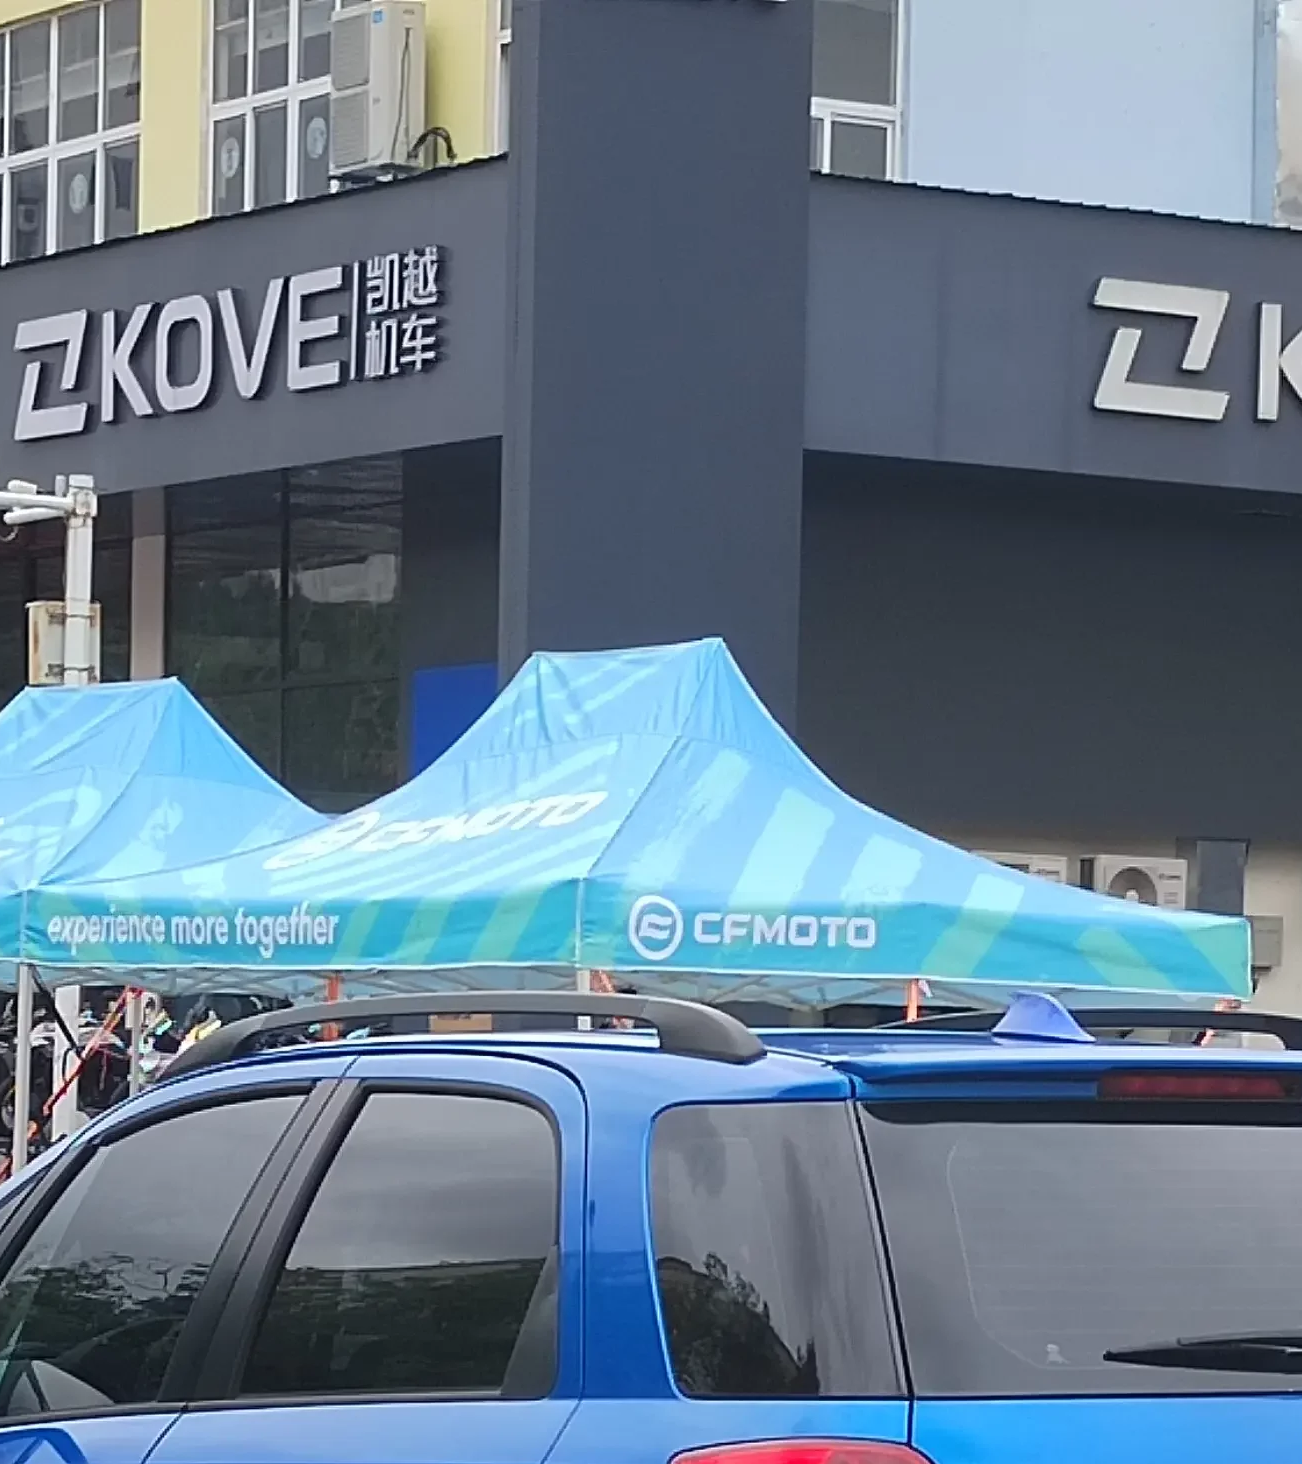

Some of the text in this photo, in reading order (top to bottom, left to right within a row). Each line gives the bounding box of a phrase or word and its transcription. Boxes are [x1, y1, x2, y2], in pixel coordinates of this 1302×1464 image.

[366, 245, 438, 314] 凯越
[101, 265, 343, 423] KOVE
[365, 312, 437, 376] 机车
[47, 900, 339, 959] experience more together
[694, 912, 876, 948] CFMOTO
